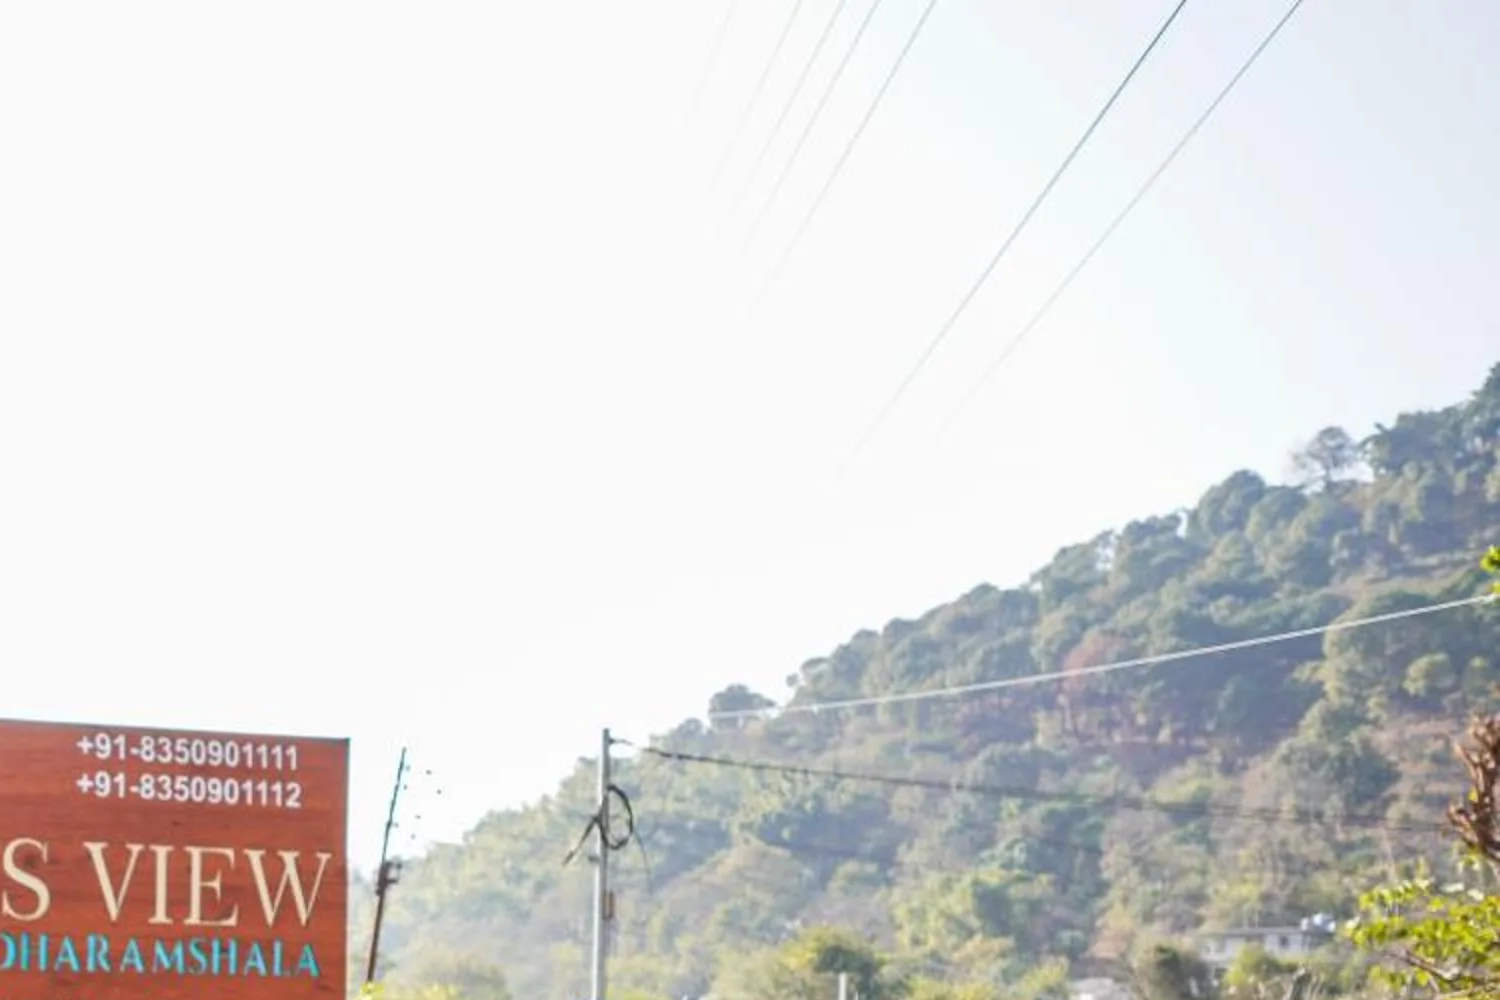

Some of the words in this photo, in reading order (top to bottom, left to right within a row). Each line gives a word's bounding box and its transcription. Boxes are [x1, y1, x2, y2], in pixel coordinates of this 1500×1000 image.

[76, 733, 298, 771] +91-8350901111
[76, 771, 302, 808] +91-8350901112
[83, 840, 333, 928] VIEW
